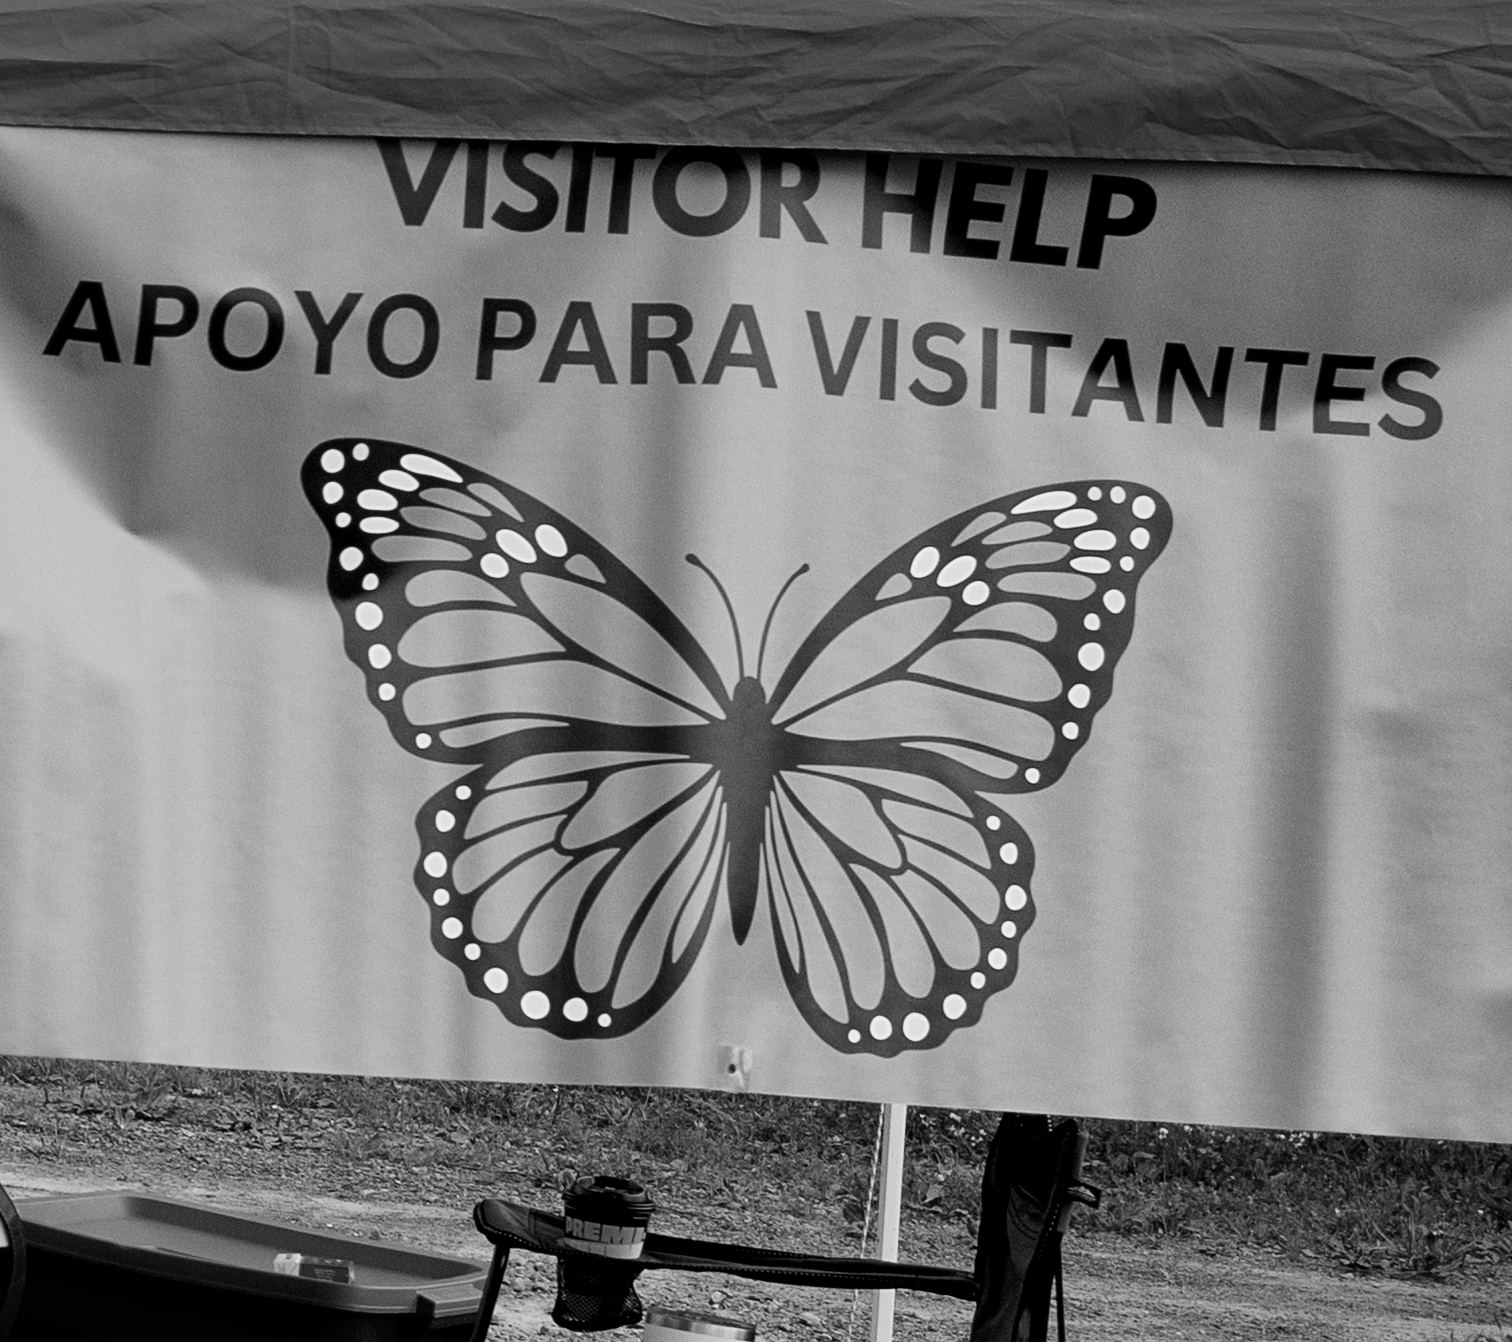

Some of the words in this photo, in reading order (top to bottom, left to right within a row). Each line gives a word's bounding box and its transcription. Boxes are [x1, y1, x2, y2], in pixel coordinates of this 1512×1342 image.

[376, 139, 830, 245] VISITOR
[861, 152, 1158, 269] HELP
[42, 280, 441, 379] APOYO
[476, 297, 778, 389] PARA
[807, 311, 1443, 441] VISITANTES
